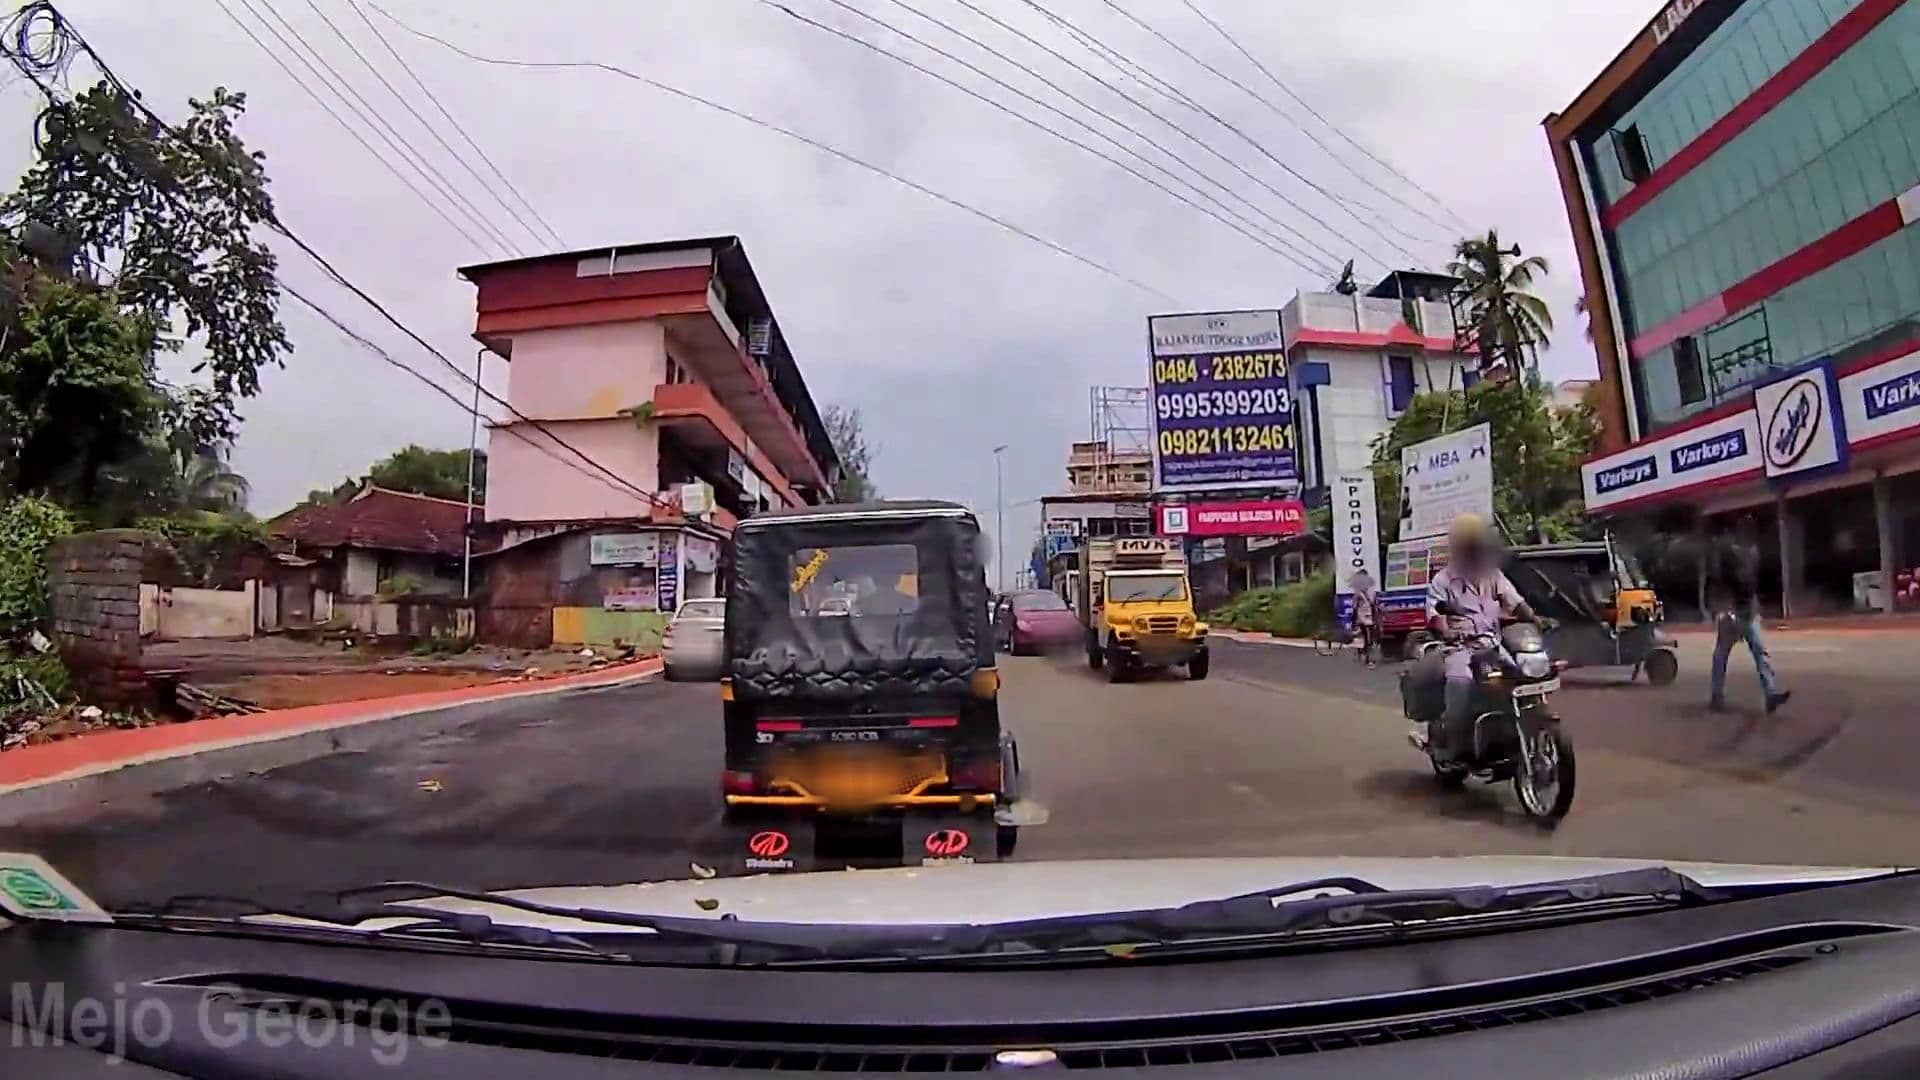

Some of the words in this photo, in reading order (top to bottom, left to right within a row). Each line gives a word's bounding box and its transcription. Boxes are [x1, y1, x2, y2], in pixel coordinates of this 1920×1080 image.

[1155, 358, 1198, 384] 0484
[1212, 354, 1286, 380] 2382673
[1157, 388, 1290, 418] 9995399203
[1160, 424, 1293, 456] 09821132461
[1677, 436, 1740, 466] Varkeys
[1428, 450, 1460, 470] MBA
